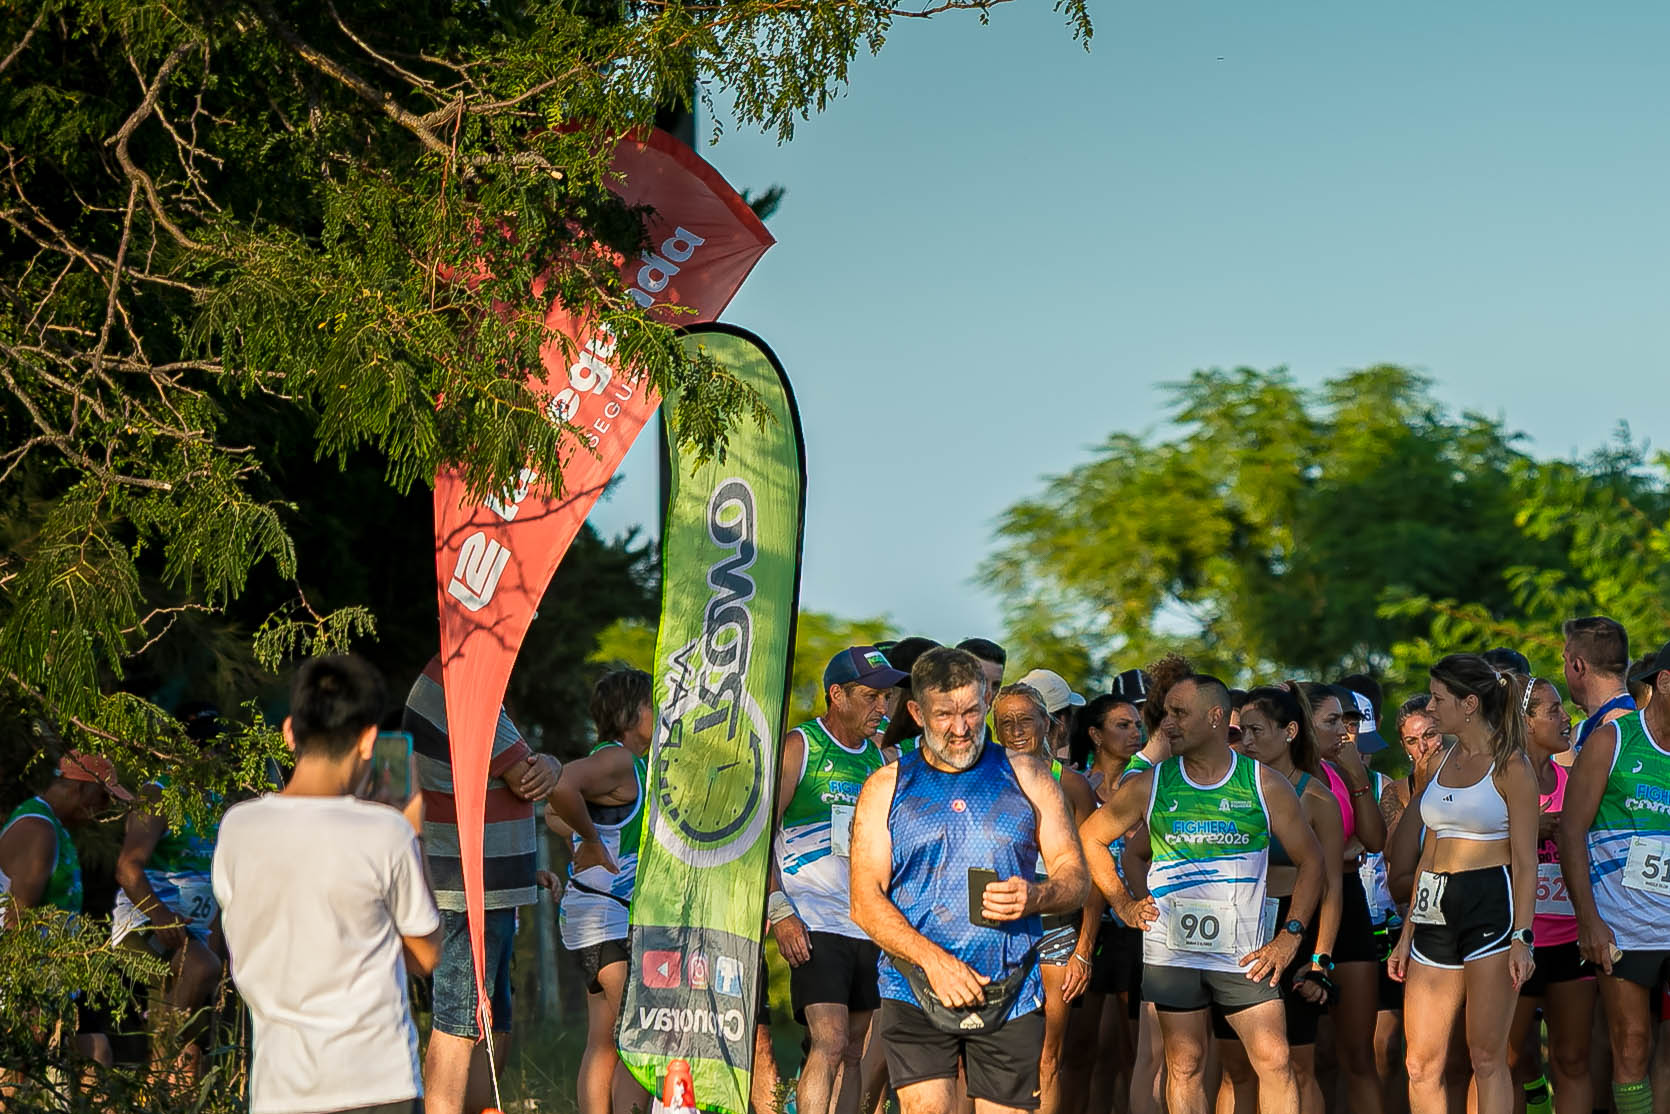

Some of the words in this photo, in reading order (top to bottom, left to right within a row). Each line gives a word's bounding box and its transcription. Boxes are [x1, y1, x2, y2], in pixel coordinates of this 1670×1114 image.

[1172, 820, 1239, 834] FIGHIERA
[1536, 876, 1568, 902] 52
[191, 896, 212, 918] 26
[1180, 913, 1220, 941] 90
